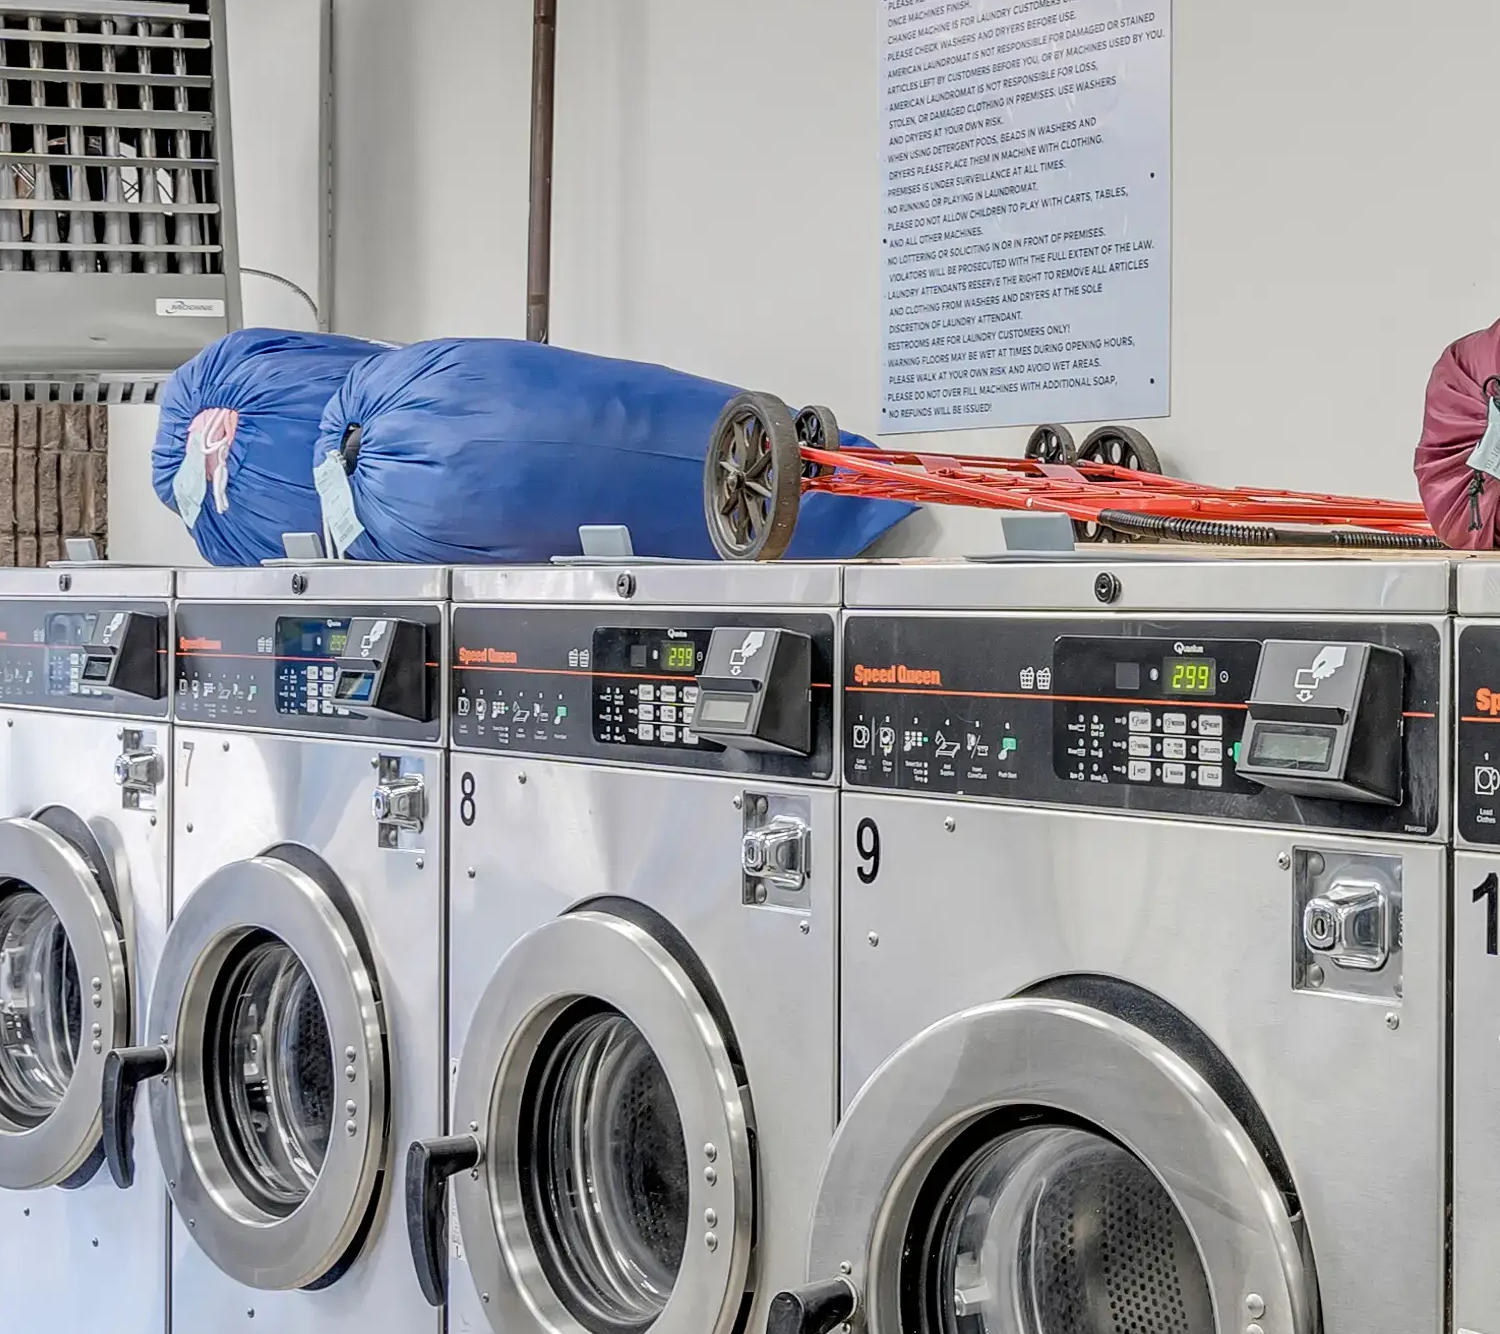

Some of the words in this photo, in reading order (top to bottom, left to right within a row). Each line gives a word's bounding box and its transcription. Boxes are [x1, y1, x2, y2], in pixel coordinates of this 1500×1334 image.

[888, 409, 899, 419] NO
[900, 406, 932, 418] REFUNDS
[933, 405, 950, 416] WILL
[952, 404, 961, 414] BE
[962, 402, 992, 414] ISSUED!
[668, 648, 693, 667] 299
[854, 664, 894, 685] Speed
[897, 665, 941, 686] Queen
[1172, 665, 1208, 689] 299
[183, 741, 195, 787] 7
[460, 771, 476, 827] 8
[855, 816, 880, 885] 9
